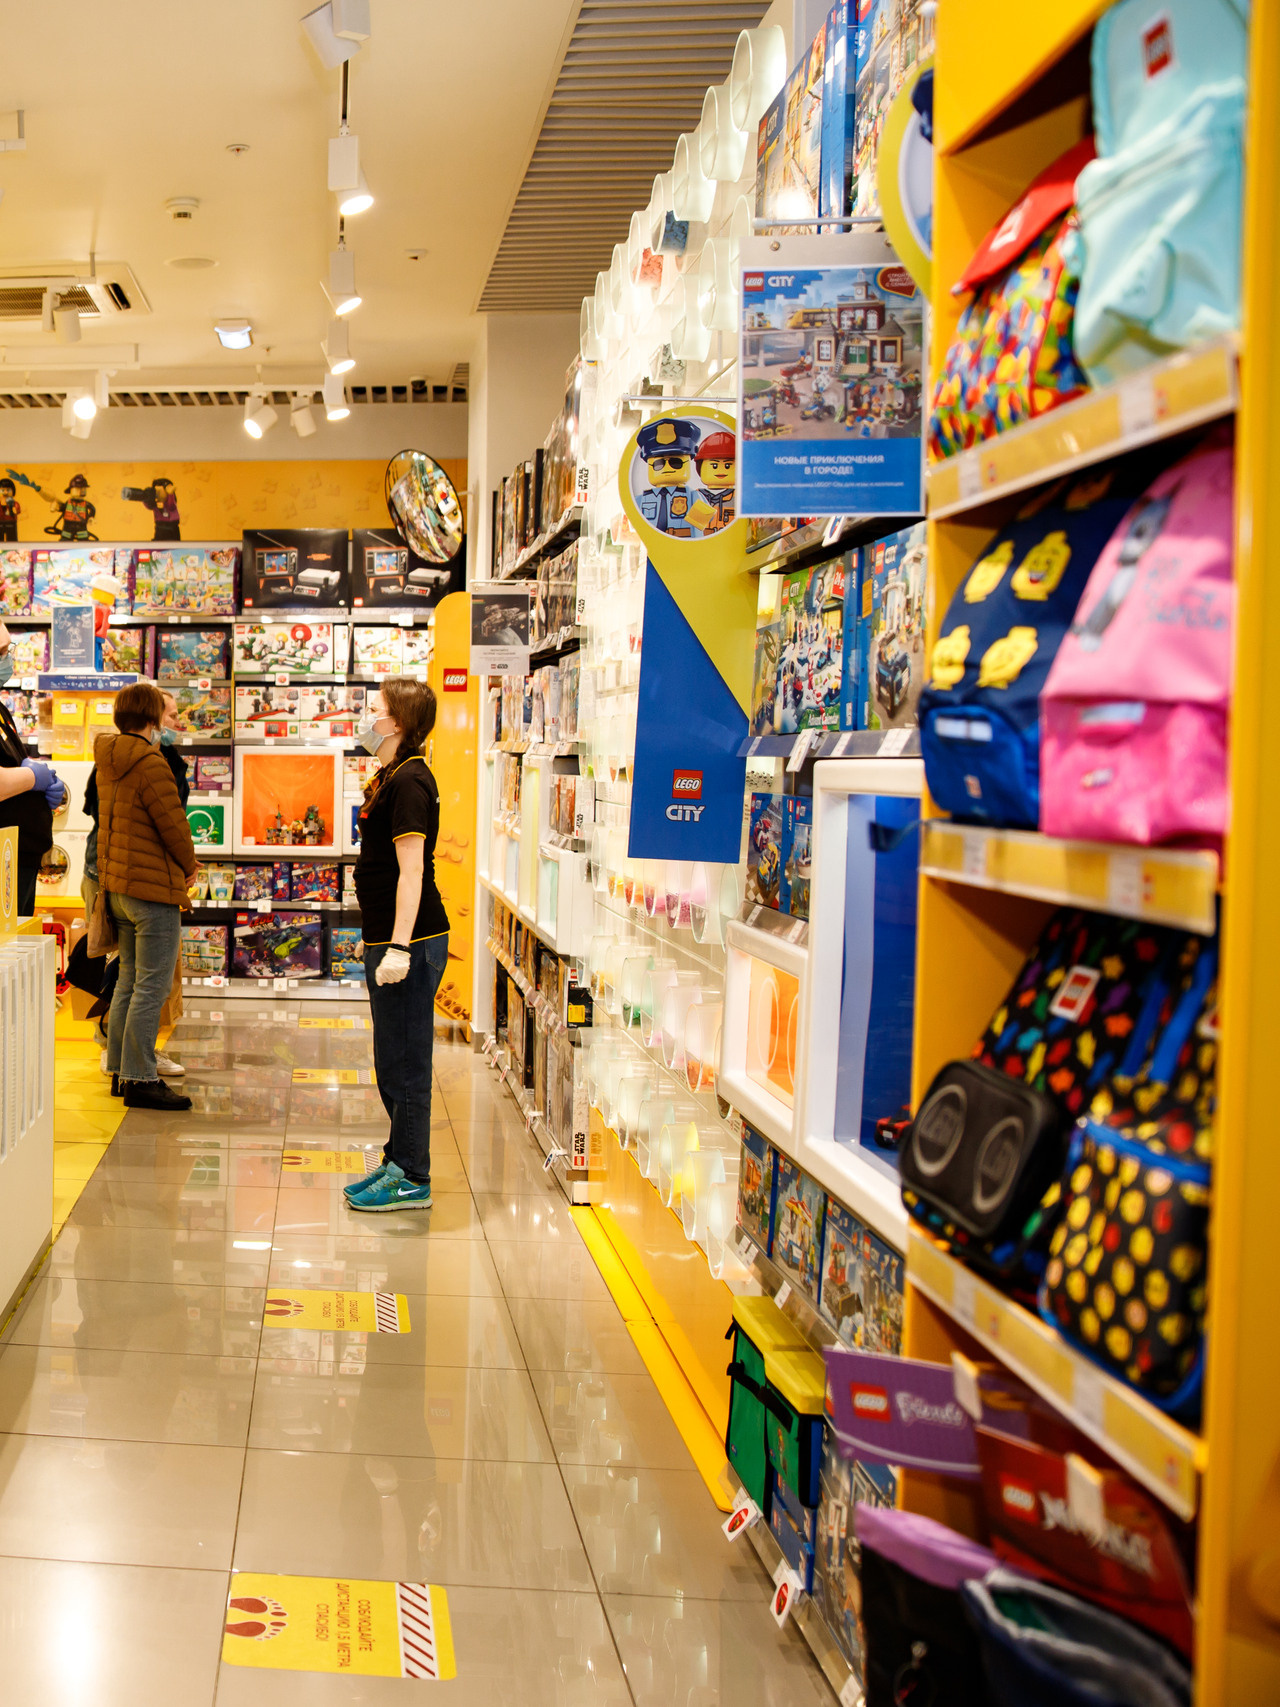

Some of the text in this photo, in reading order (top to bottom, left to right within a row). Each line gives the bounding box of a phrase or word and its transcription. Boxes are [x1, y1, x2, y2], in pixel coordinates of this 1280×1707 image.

[744, 275, 796, 287] LEGO CITY
[774, 454, 885, 465] НОВЫЕ ПРИКЛЮЧЕНИЯ
[804, 465, 855, 475] В ГОРОДЕ!
[884, 544, 897, 564] CITY
[789, 581, 801, 598] CITY
[444, 676, 467, 685] LEGO
[673, 776, 701, 791] LEGO
[665, 803, 706, 822] CITY
[579, 1131, 587, 1156] WARS
[853, 1391, 965, 1425] LEGO Friends
[335, 1582, 351, 1629] ДИСТАНЦИЮ
[315, 1603, 330, 1642] СПАСИБО!
[357, 1599, 376, 1653] СОБЛЮДАЙТЕ
[336, 1642, 351, 1668] МЕТРА
